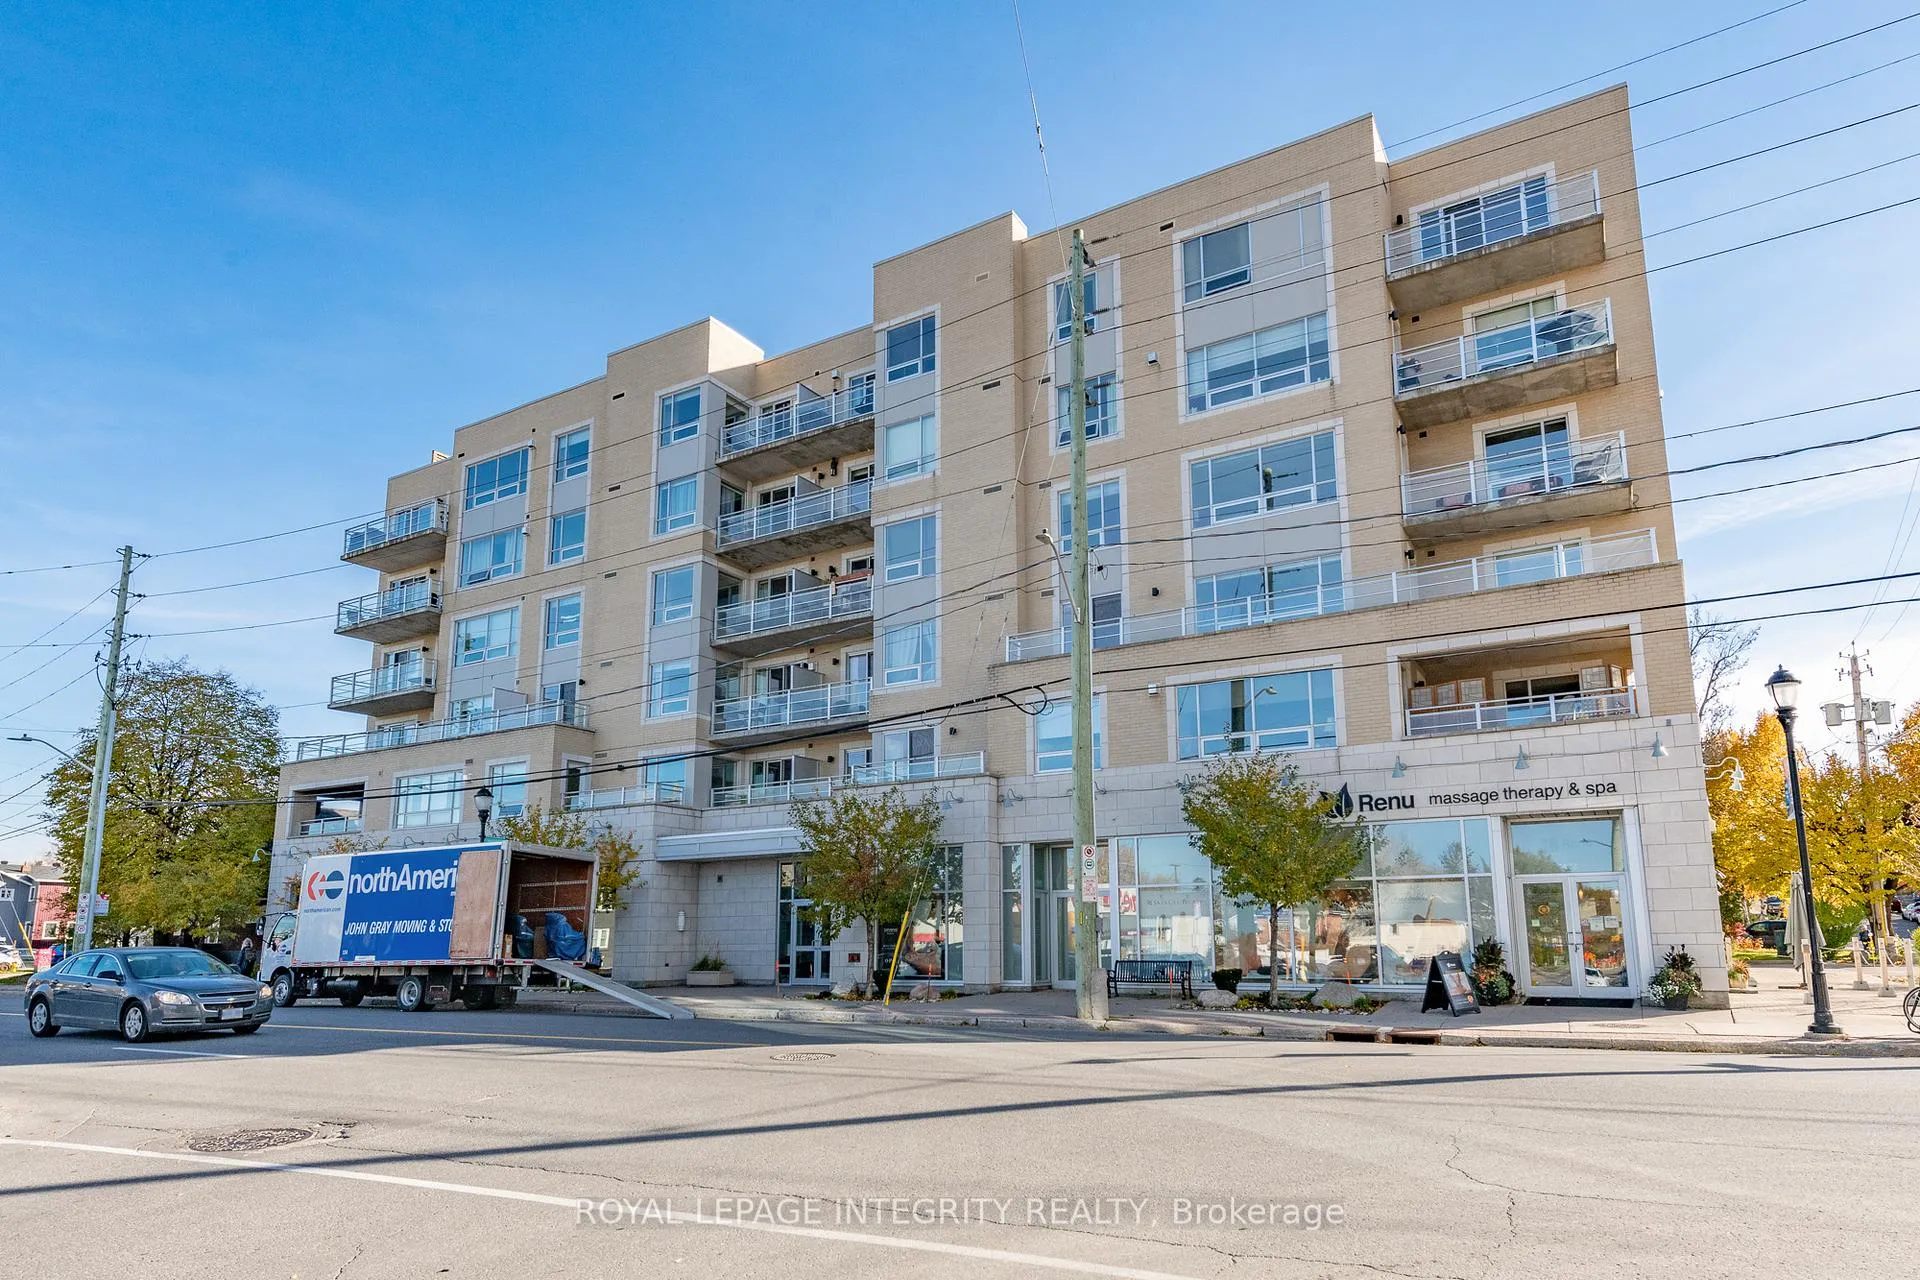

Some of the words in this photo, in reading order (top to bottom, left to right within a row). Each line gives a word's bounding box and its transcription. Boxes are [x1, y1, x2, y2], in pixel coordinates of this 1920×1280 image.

[1358, 794, 1415, 812] Renu
[1429, 790, 1499, 805] massage
[1503, 786, 1563, 801] therapy
[1568, 782, 1580, 796] &
[1586, 782, 1617, 797] spa
[344, 922, 368, 936] JOHN
[369, 920, 392, 935] GRAY
[393, 919, 427, 934] MOVING
[429, 919, 435, 933] &
